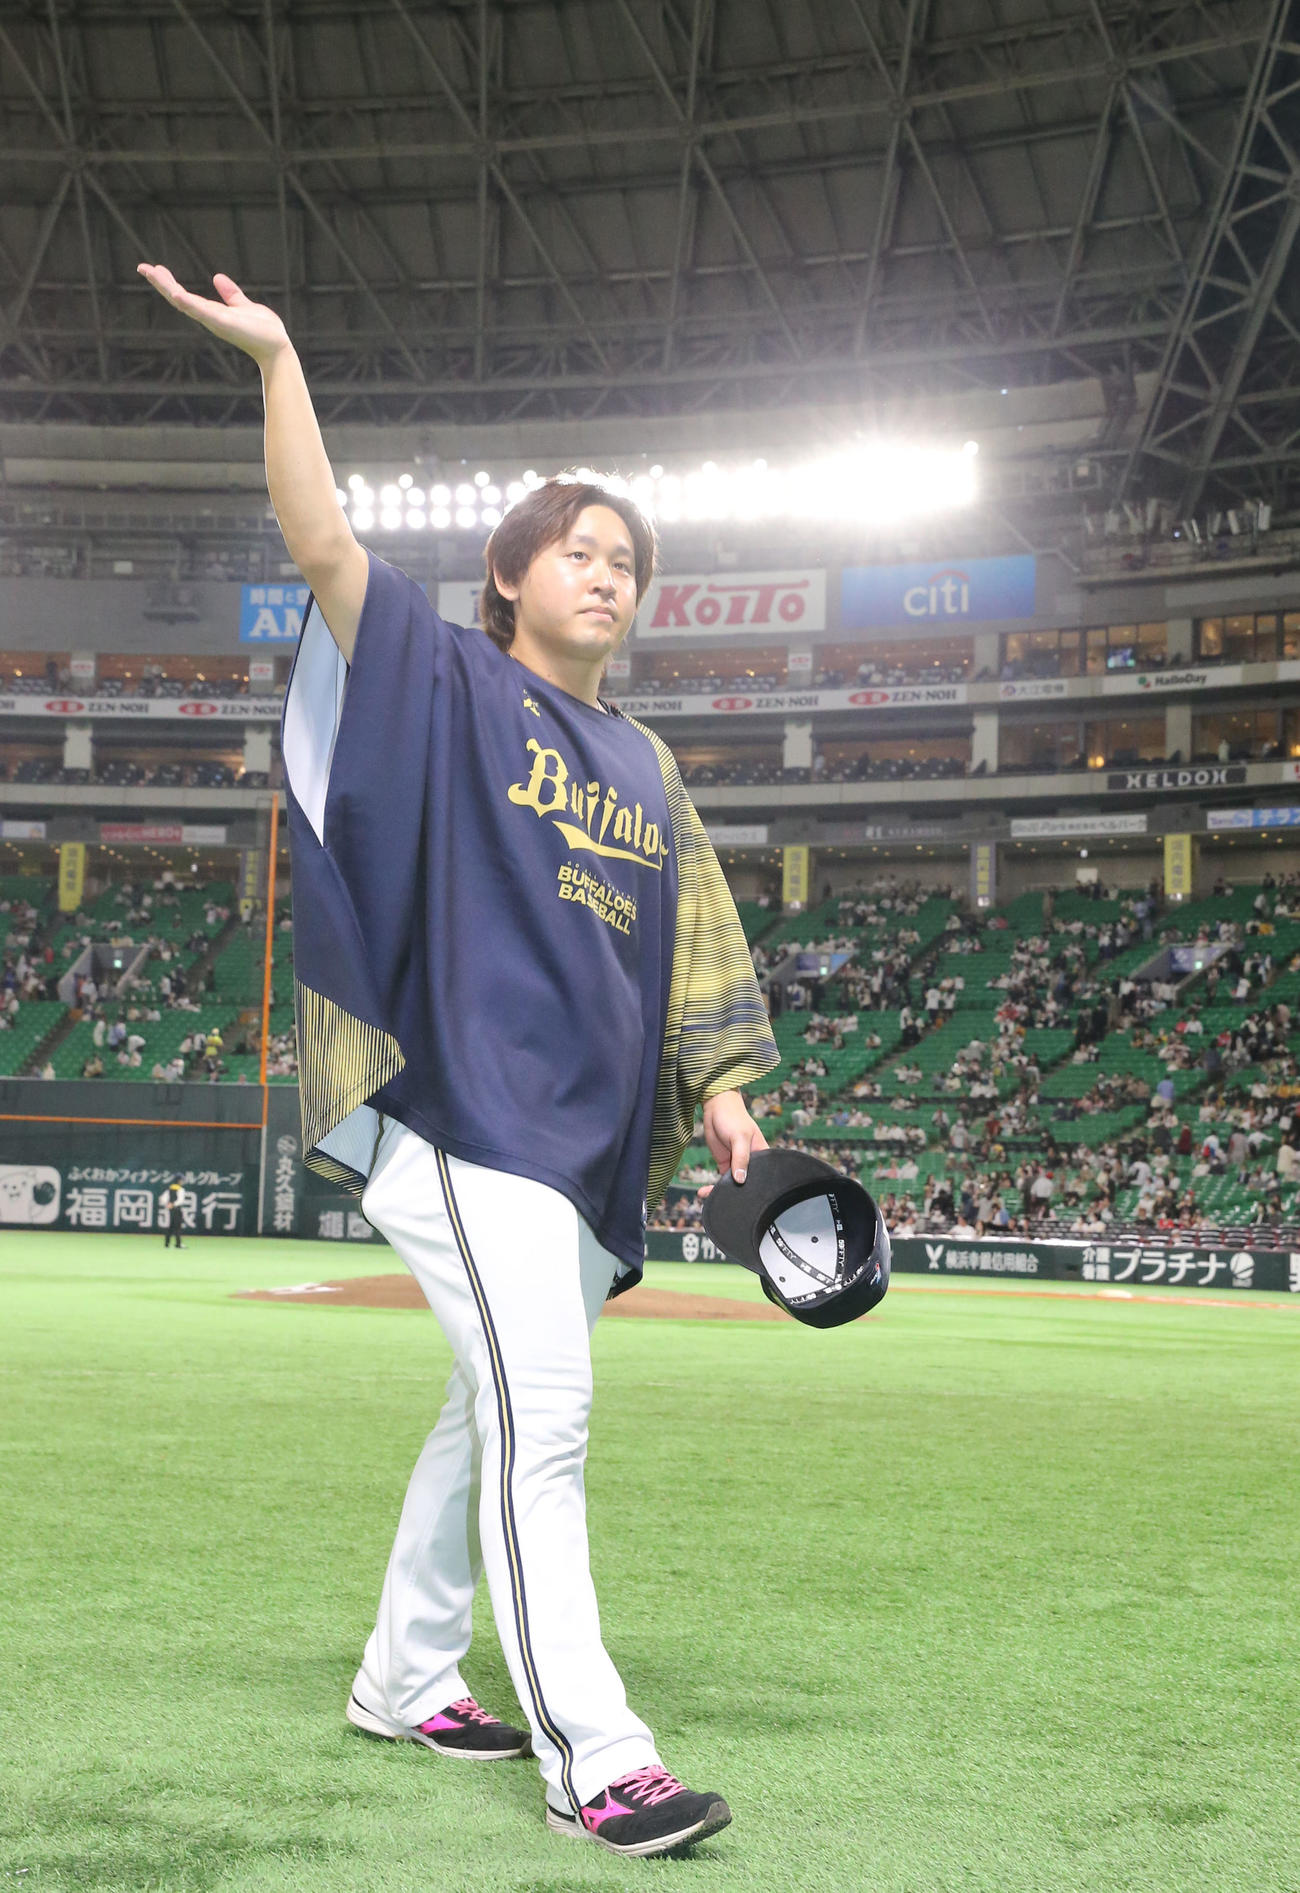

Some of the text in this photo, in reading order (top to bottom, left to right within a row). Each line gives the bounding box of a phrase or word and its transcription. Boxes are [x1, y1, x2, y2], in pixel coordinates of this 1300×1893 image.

[904, 575, 970, 616] citi
[557, 865, 637, 921] BUFFALOES
[557, 882, 631, 936] BASEBALL
[67, 1166, 243, 1187] ふくおかフィナンシルグループ
[65, 1187, 243, 1231] 福岡銀行
[1113, 1248, 1227, 1285] プラチナ
